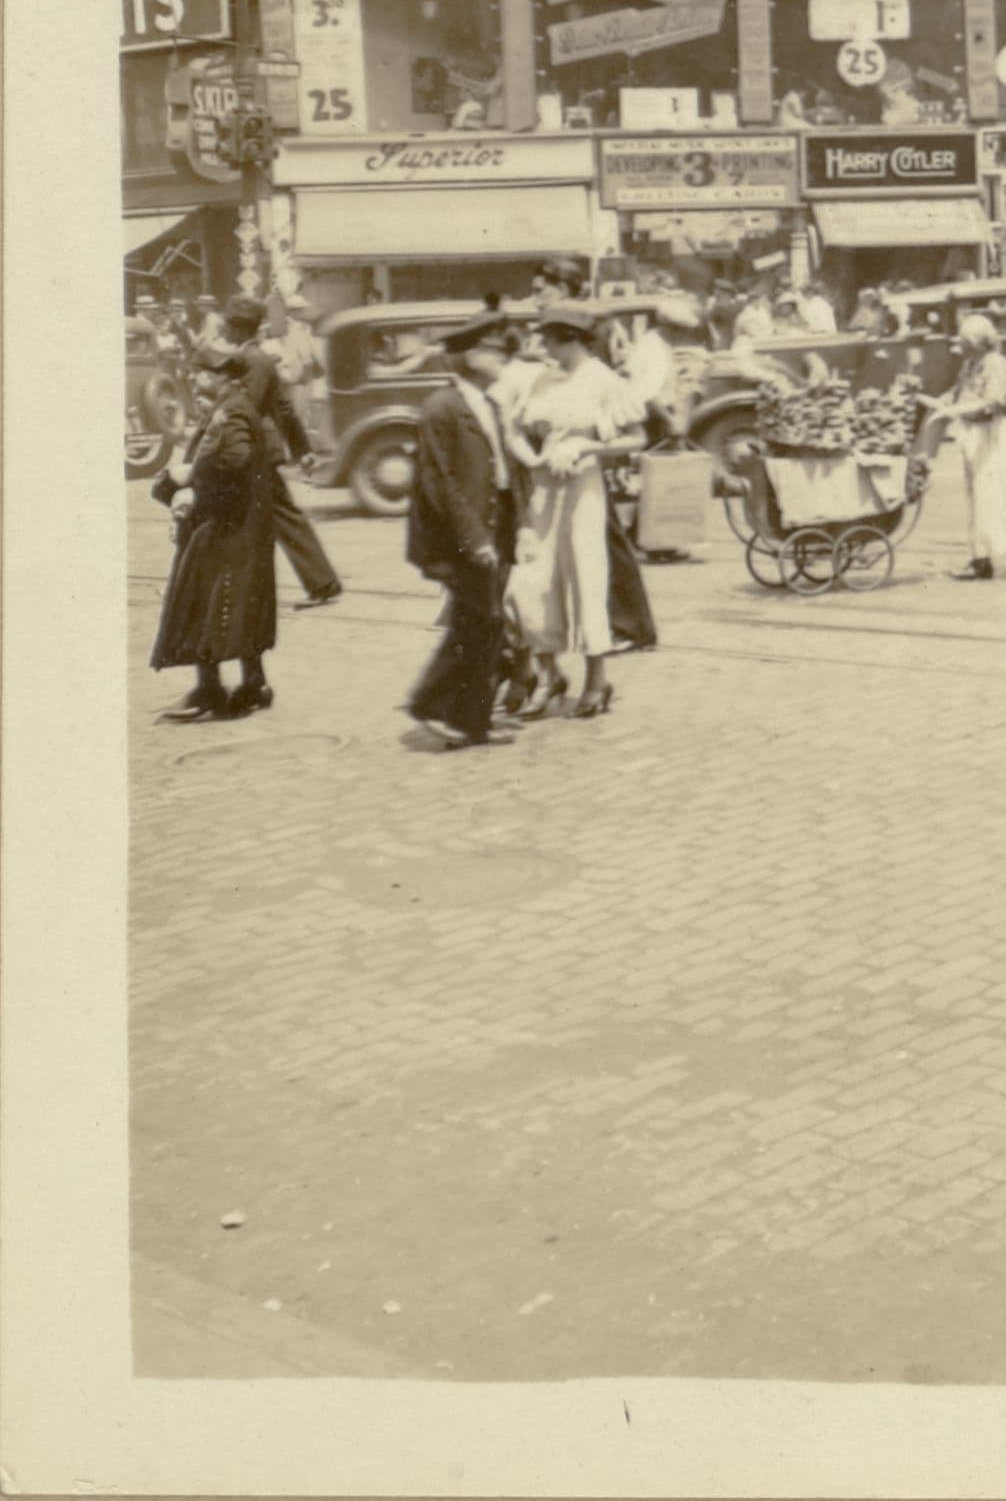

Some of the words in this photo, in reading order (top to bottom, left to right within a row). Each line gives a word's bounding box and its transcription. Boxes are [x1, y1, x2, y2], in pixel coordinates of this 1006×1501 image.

[845, 49, 879, 76] 25
[307, 88, 353, 122] 25
[364, 141, 504, 182] Superior
[682, 151, 716, 188] 3
[825, 148, 888, 180] HARRY
